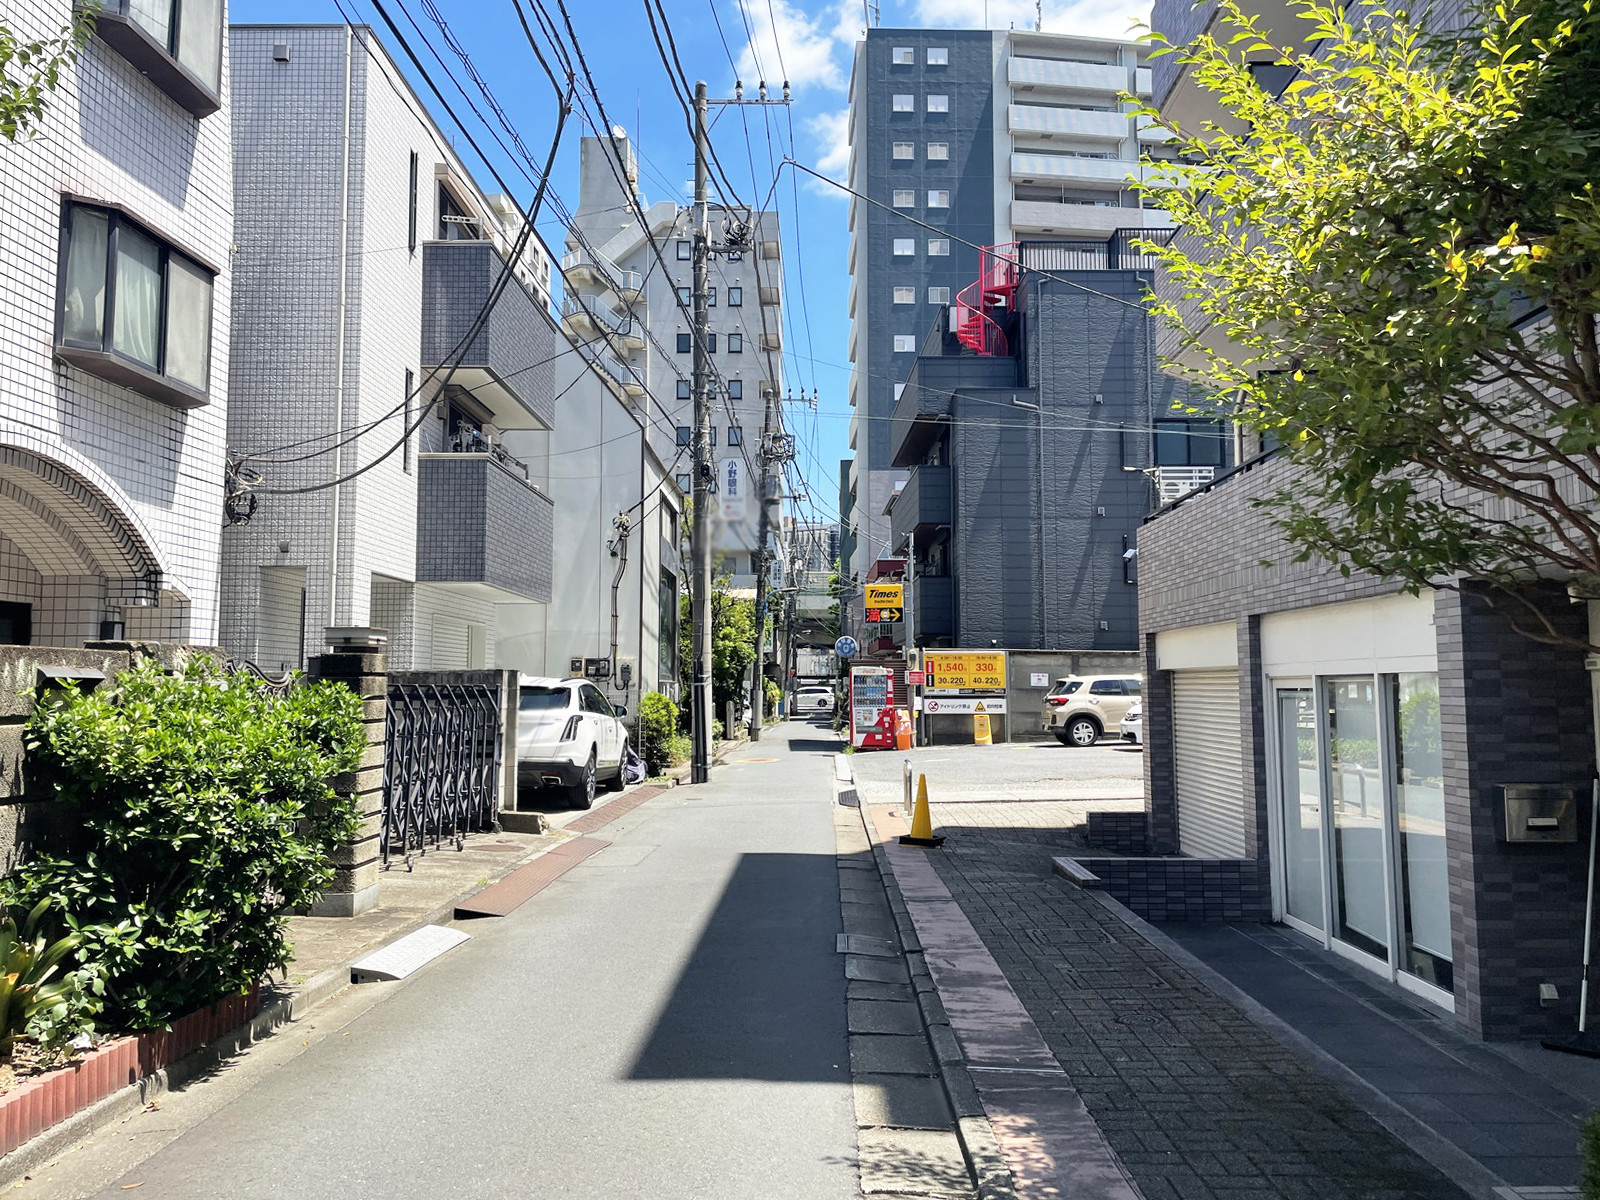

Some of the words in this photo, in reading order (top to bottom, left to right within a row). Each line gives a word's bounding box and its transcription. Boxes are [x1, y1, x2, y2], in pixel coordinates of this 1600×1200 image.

[728, 460, 737, 496] 小野眼科
[869, 589, 898, 598] Times
[866, 608, 880, 623] 満
